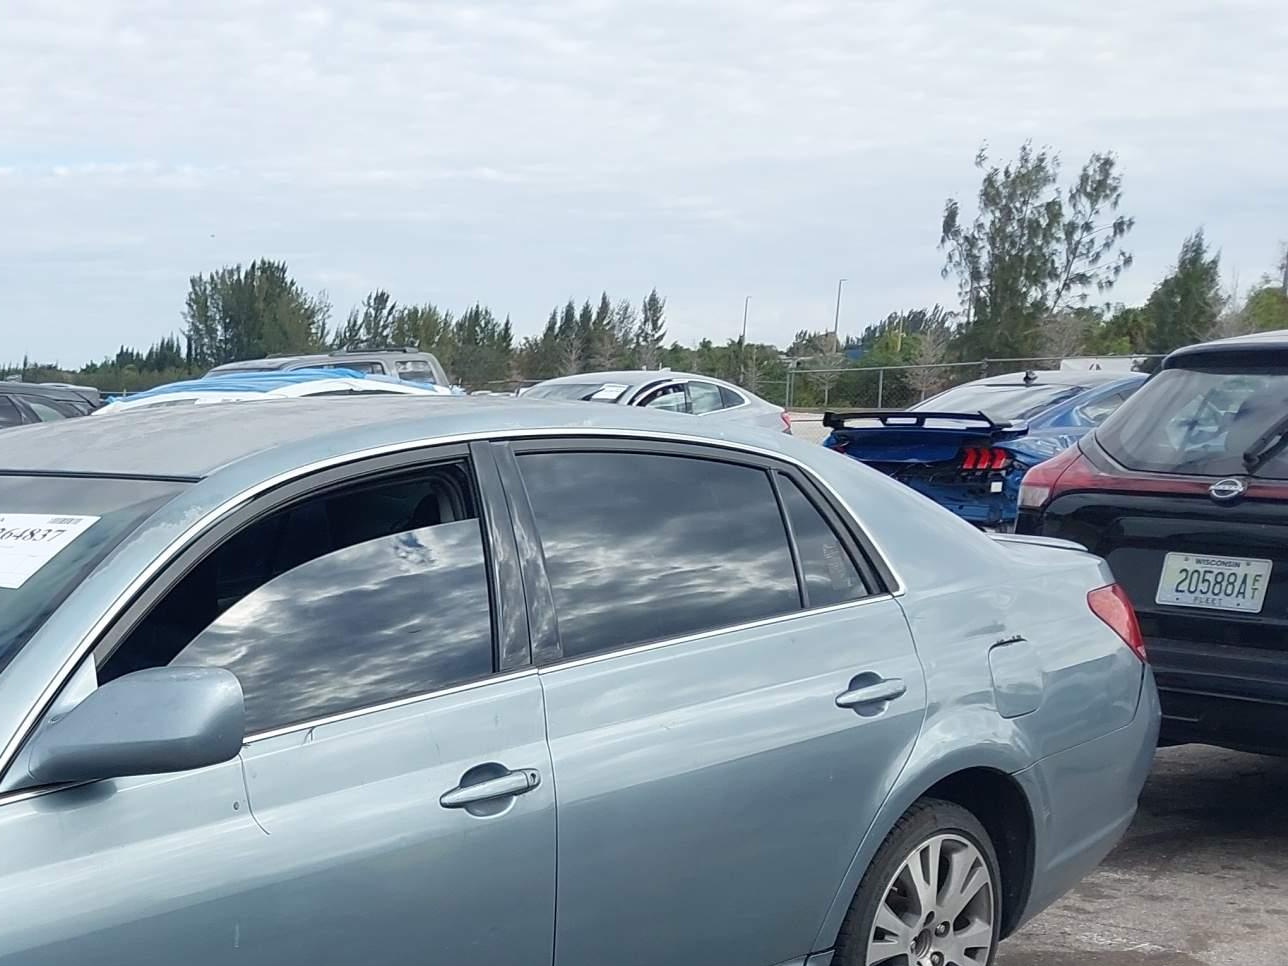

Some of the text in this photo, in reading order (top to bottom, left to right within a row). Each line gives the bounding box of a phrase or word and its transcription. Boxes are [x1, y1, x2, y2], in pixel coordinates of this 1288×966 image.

[1195, 558, 1241, 568] WISCONSIN
[1175, 568, 1248, 599] 20588A
[1193, 596, 1224, 606] FLEET
